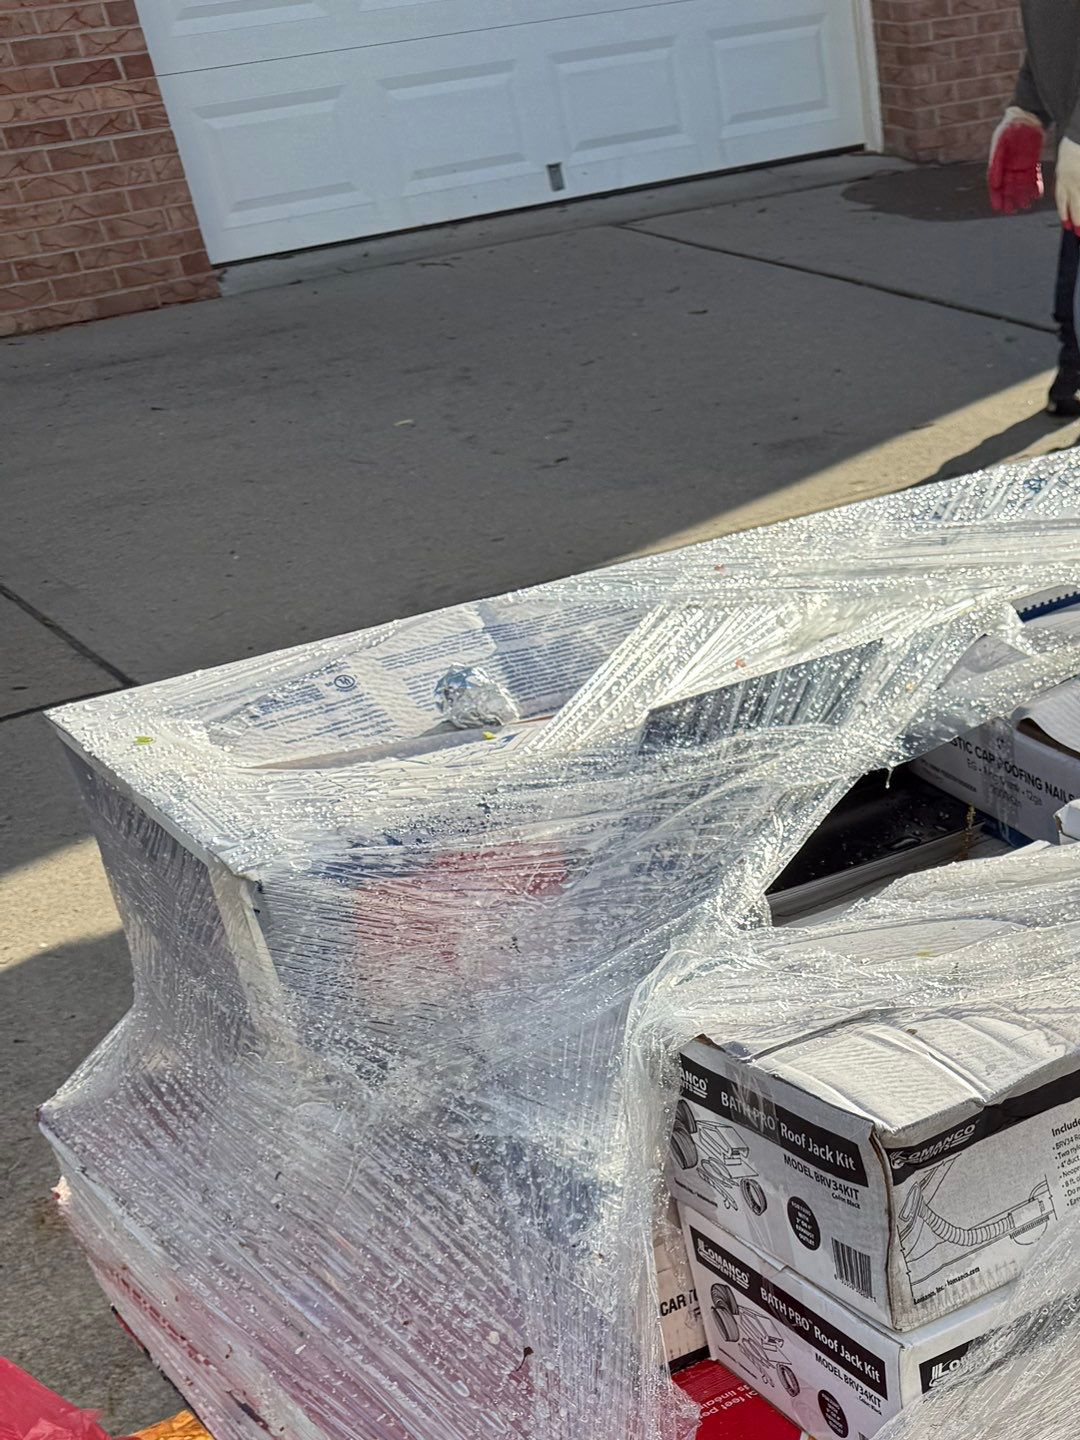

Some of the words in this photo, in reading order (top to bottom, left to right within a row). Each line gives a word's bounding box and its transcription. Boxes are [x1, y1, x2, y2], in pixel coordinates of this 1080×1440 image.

[975, 746, 996, 762] CAP
[780, 1122, 806, 1149] Roof
[808, 1138, 834, 1164] Jack
[836, 1150, 857, 1171] Kit
[1067, 1154, 1080, 1166] duct
[783, 1153, 814, 1179] MODEL
[760, 1286, 788, 1316] BATH
[813, 1325, 839, 1354] Roof
[840, 1344, 863, 1371] Jack
[864, 1361, 881, 1384] Kit
[815, 1352, 843, 1381] MODEL
